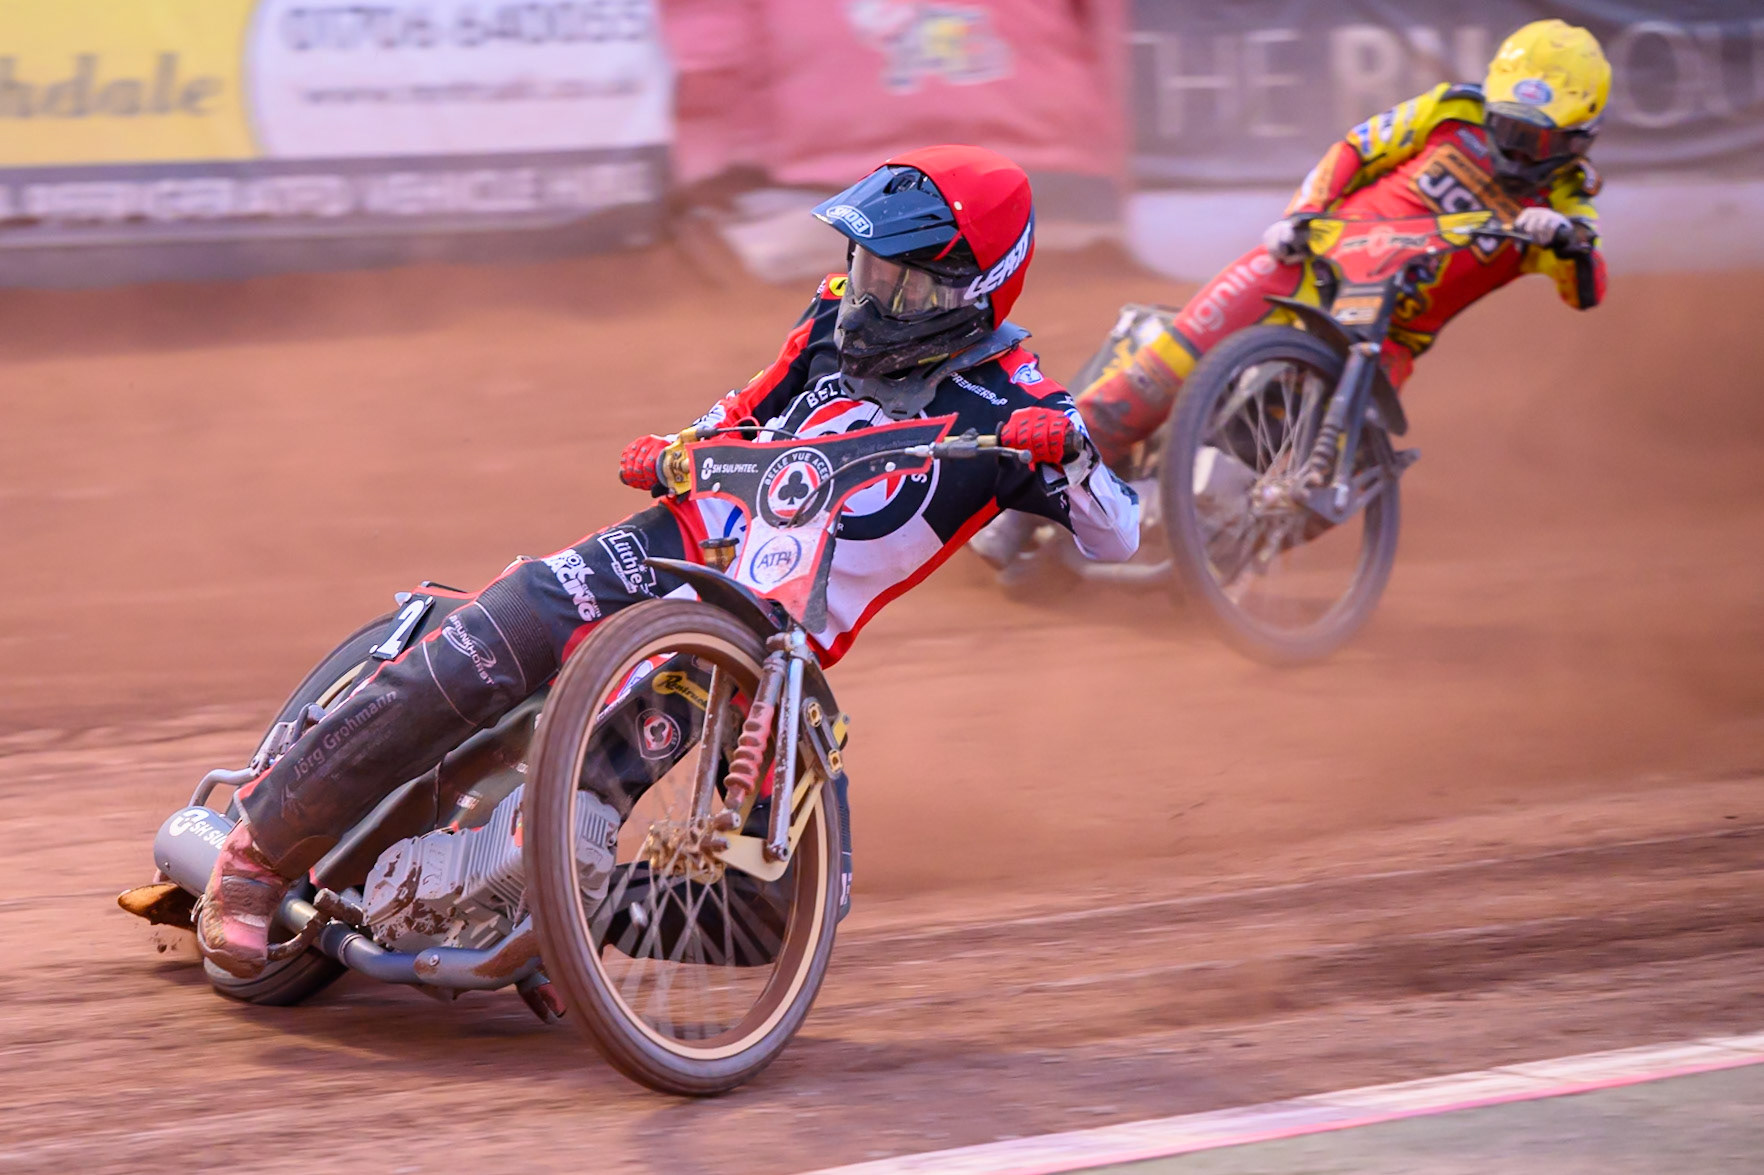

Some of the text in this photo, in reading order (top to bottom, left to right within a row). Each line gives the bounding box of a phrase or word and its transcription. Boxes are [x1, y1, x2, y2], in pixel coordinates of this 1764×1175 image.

[828, 207, 870, 233] SHOEI
[806, 382, 846, 408] BEL
[764, 453, 831, 486] BELLE VUE ACES
[608, 534, 646, 585] Lüthje
[293, 749, 326, 781] Jörg
[322, 690, 398, 750] Grohmann
